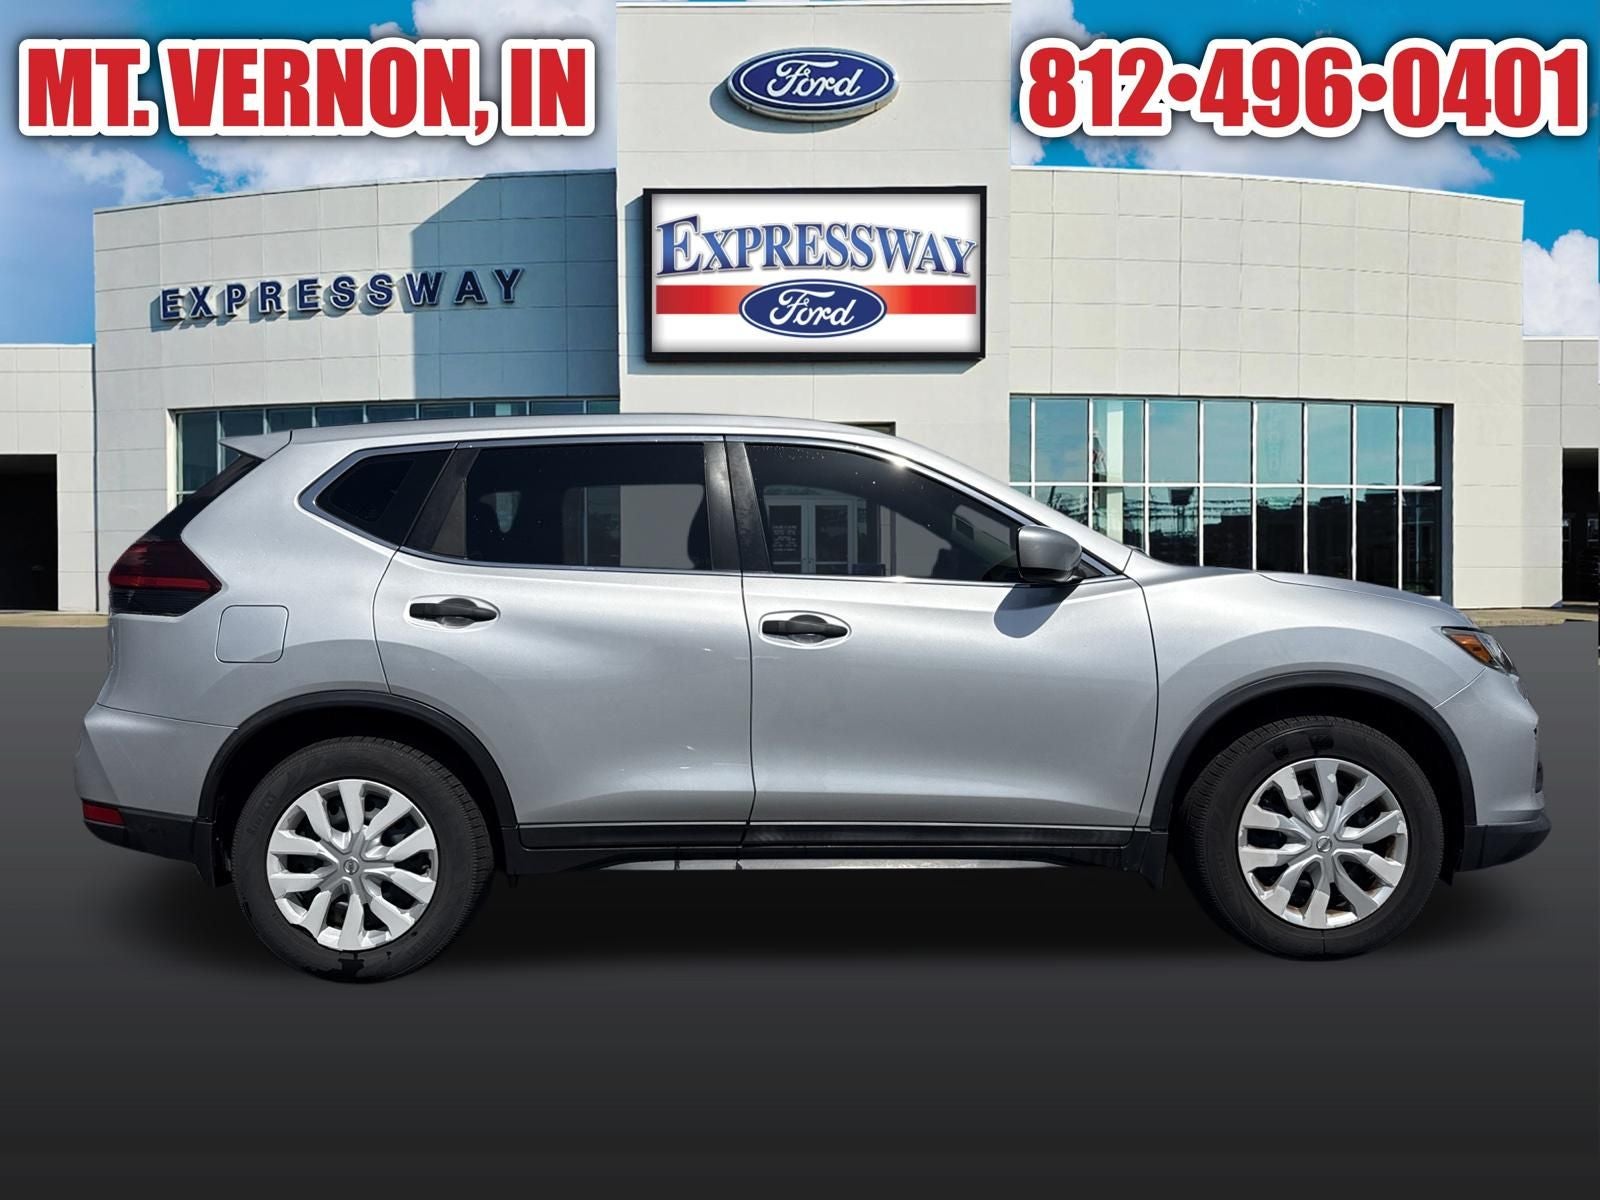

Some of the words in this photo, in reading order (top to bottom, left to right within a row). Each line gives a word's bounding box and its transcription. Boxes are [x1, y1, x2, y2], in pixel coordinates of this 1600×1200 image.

[766, 59, 863, 97] Ford
[655, 213, 977, 277] EXPRESSWAY
[159, 268, 526, 322] EXPRESSWAY
[768, 288, 856, 327] Ford
